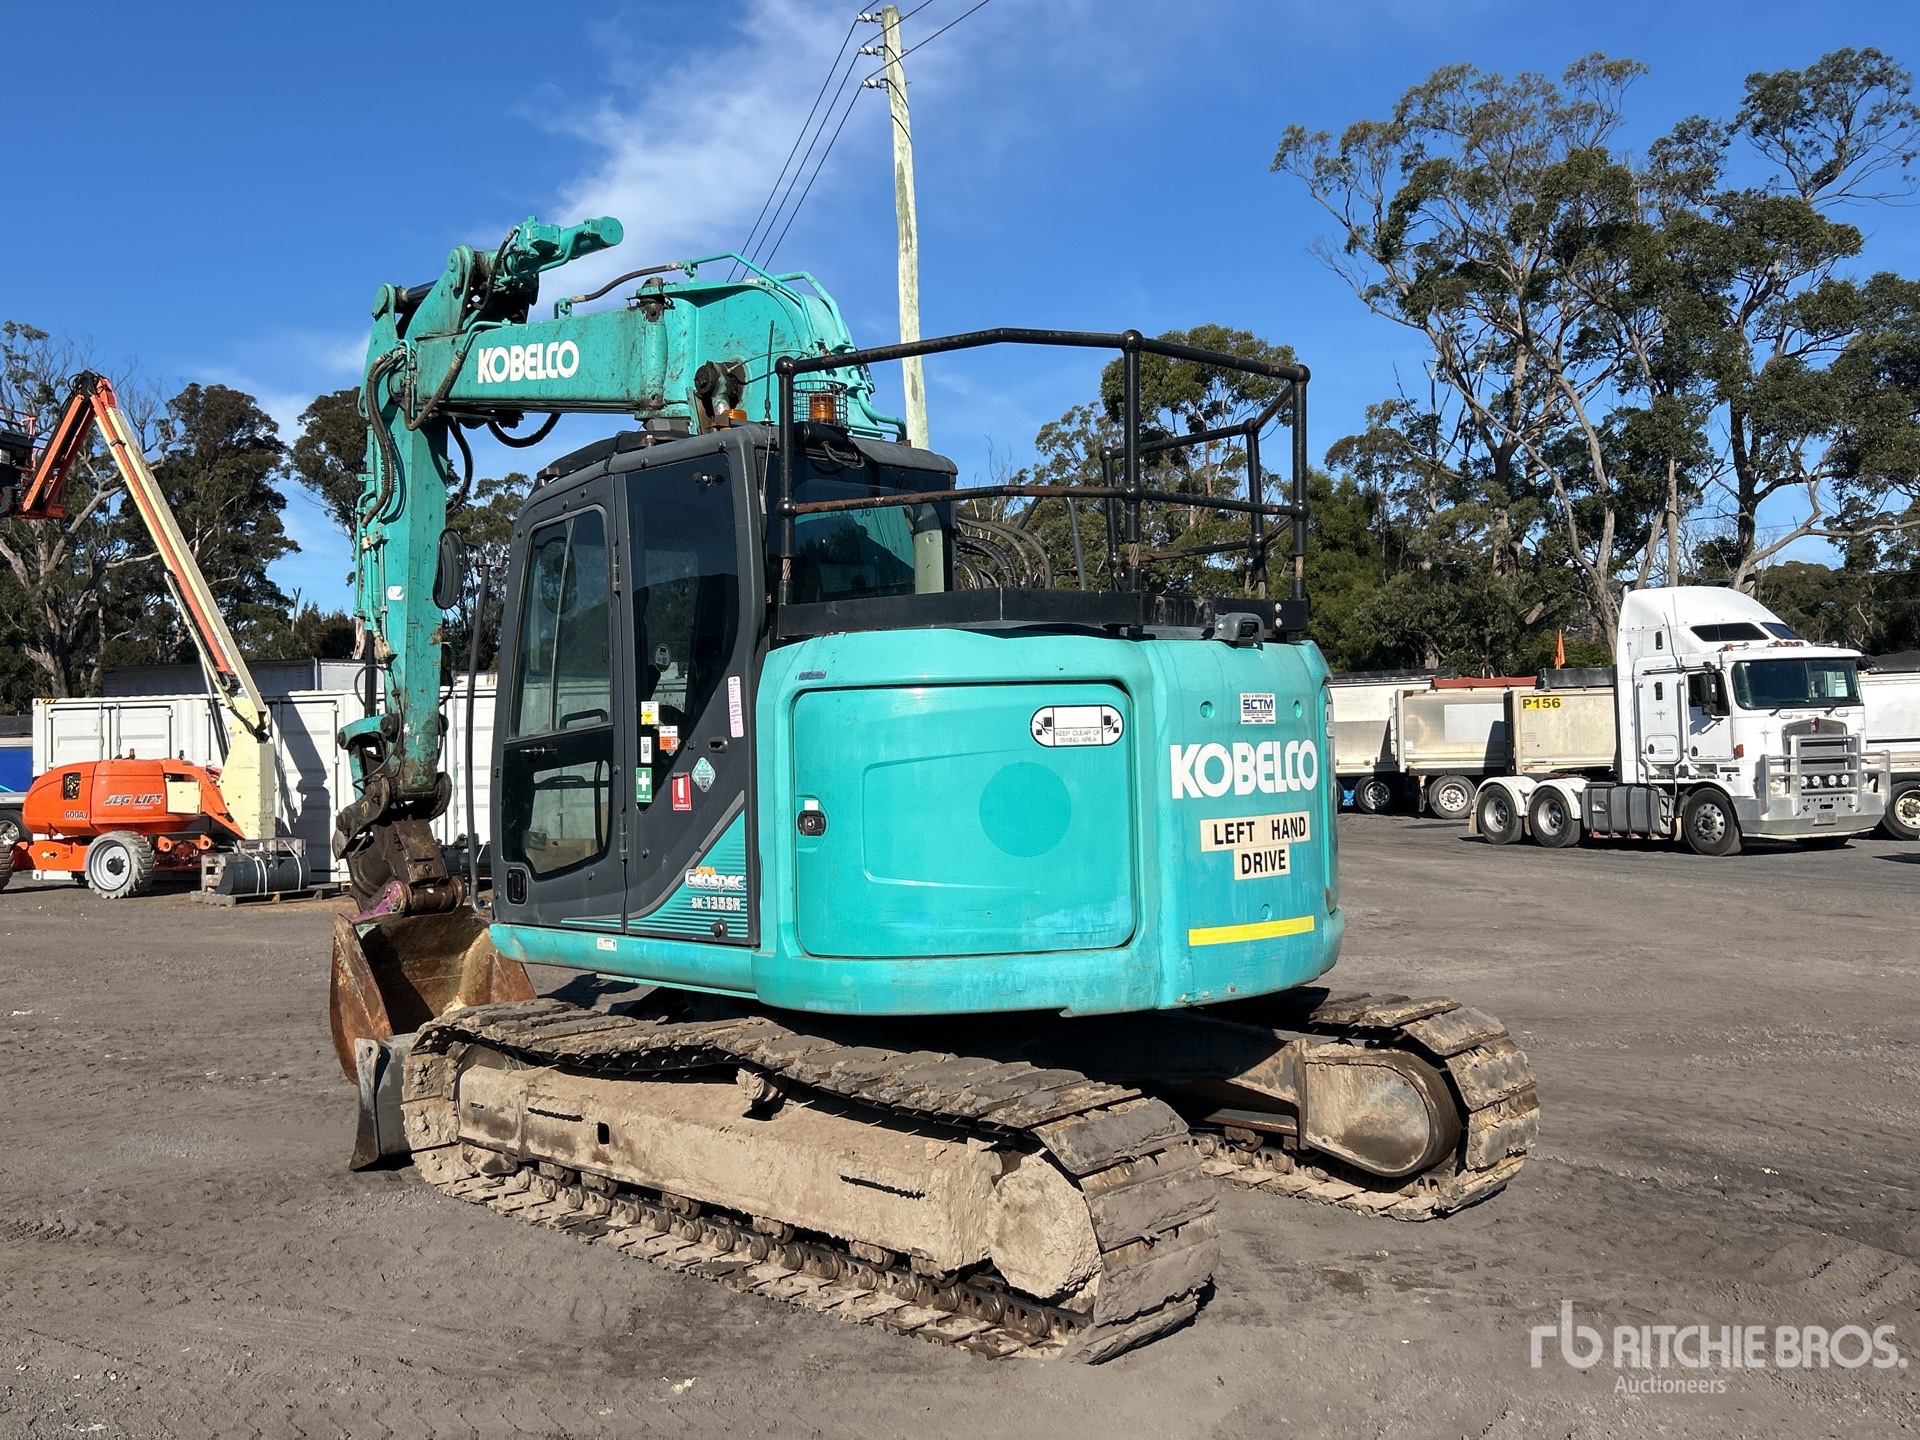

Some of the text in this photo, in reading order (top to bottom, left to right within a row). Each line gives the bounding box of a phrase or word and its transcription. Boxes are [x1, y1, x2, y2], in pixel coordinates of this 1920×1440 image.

[477, 340, 579, 384] KOBELCO
[1242, 699, 1273, 709] SCTM
[1522, 698, 1561, 709] P156
[1170, 739, 1318, 799] KOBELCO
[104, 794, 163, 805] JLG LIFT
[65, 811, 88, 819] 600AJ
[1213, 816, 1306, 845] LEFT HAND
[1241, 849, 1286, 875] DRIVE
